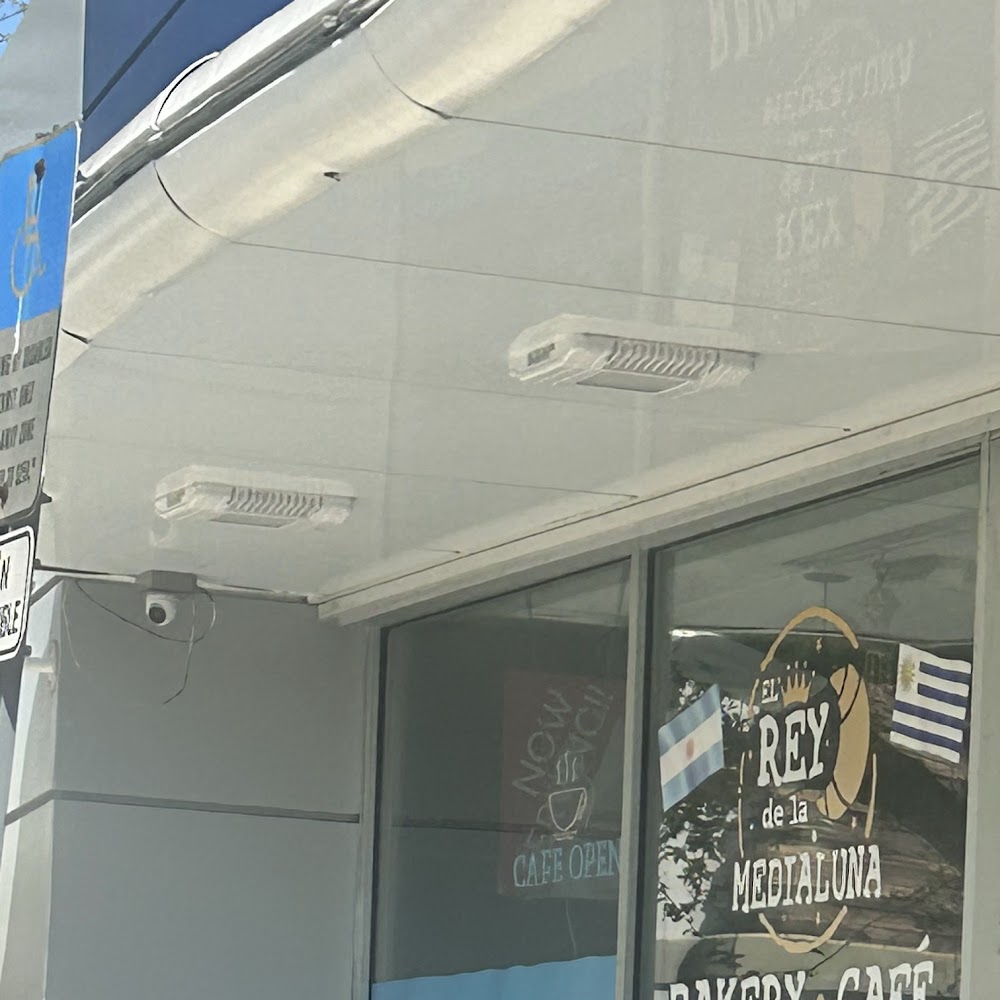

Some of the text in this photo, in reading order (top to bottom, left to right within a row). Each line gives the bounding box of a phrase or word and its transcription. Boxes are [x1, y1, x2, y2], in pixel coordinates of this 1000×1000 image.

[757, 702, 830, 787] REY
[762, 798, 808, 829] de la
[513, 838, 621, 888] CAFE OPEN
[731, 844, 882, 914] MEDIALUNA
